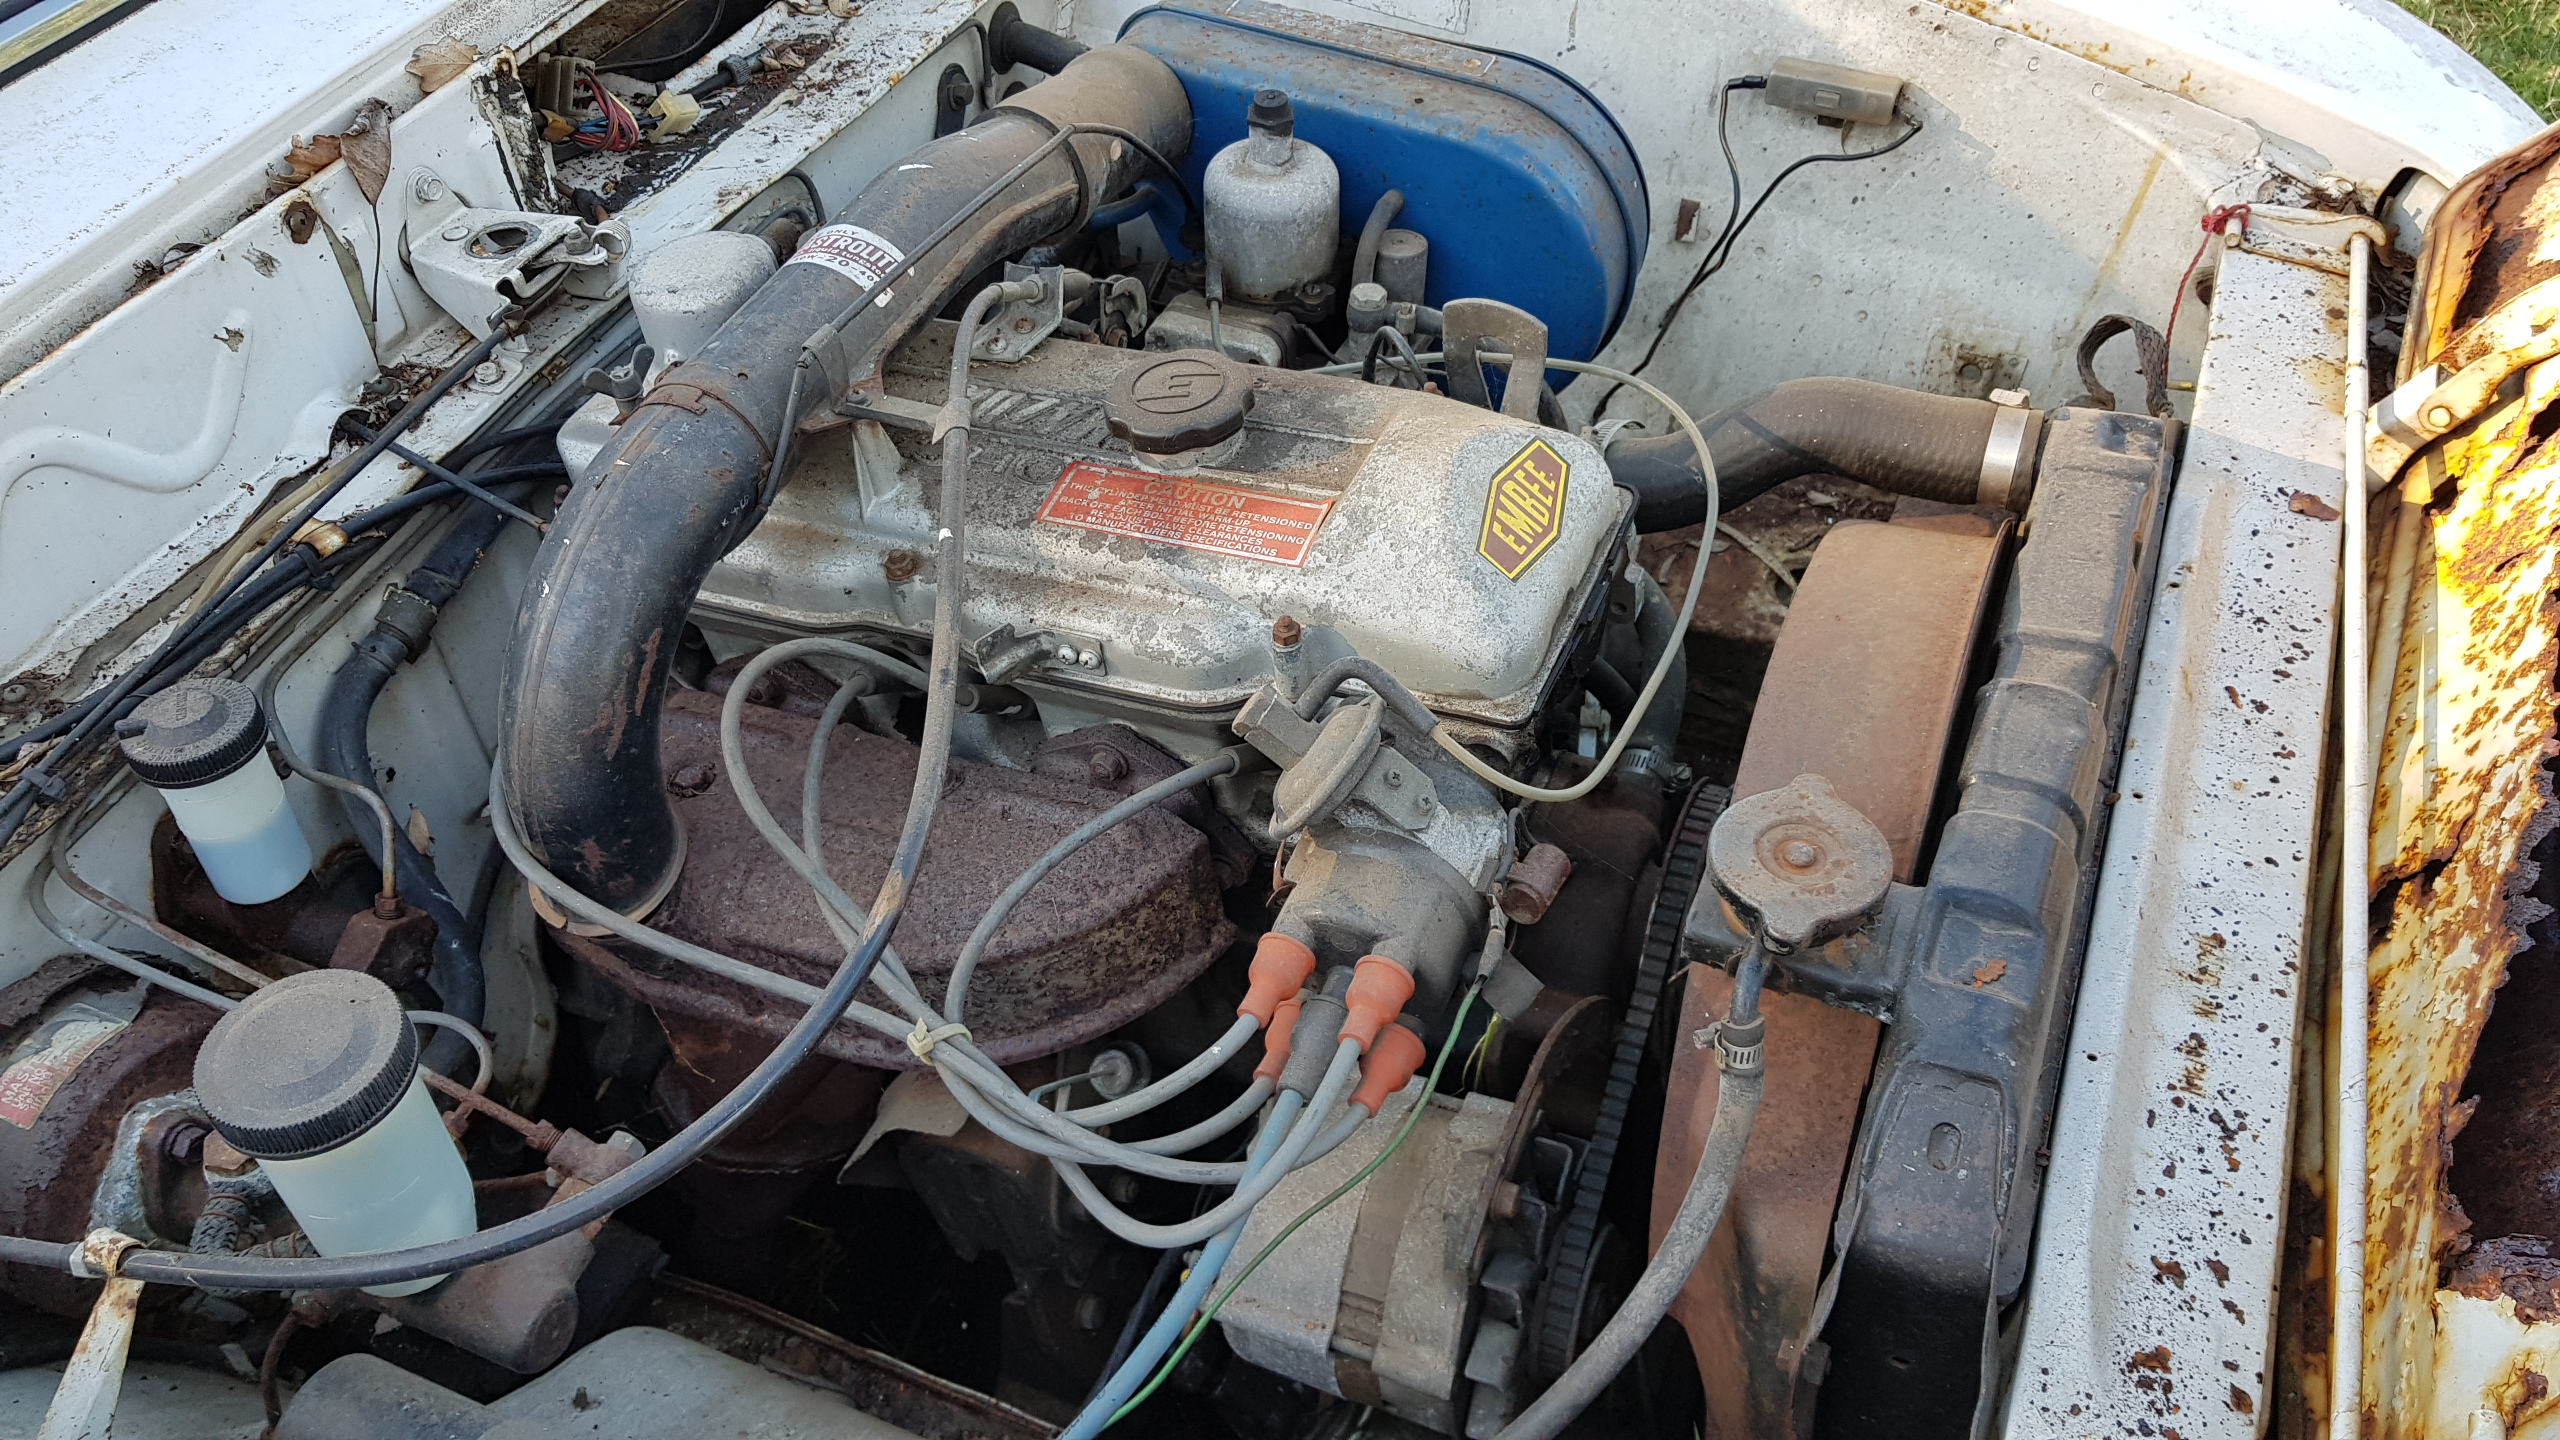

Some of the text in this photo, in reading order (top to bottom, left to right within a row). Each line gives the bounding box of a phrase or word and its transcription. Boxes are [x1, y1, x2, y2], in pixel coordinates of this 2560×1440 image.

[1098, 486, 1151, 500] CYLINDER
[1151, 495, 1180, 507] HEAD
[1182, 501, 1212, 513] MUST
[1214, 506, 1231, 516] BE
[1231, 510, 1313, 530] RETENSIONED
[1119, 499, 1251, 527] AFTER INITIAL WARM-UP
[1144, 481, 1247, 510] CAUTION
[1492, 459, 1556, 555] EMBEE
[1059, 495, 1306, 545] BACK OFF EACH BOLT BEFORE RETENSIONING
[1069, 513, 1278, 557] TO MANUFACTURERS SPECIFICATIONS
[1152, 520, 1186, 532] VALVE
[1188, 527, 1263, 546] CLEARANCES
